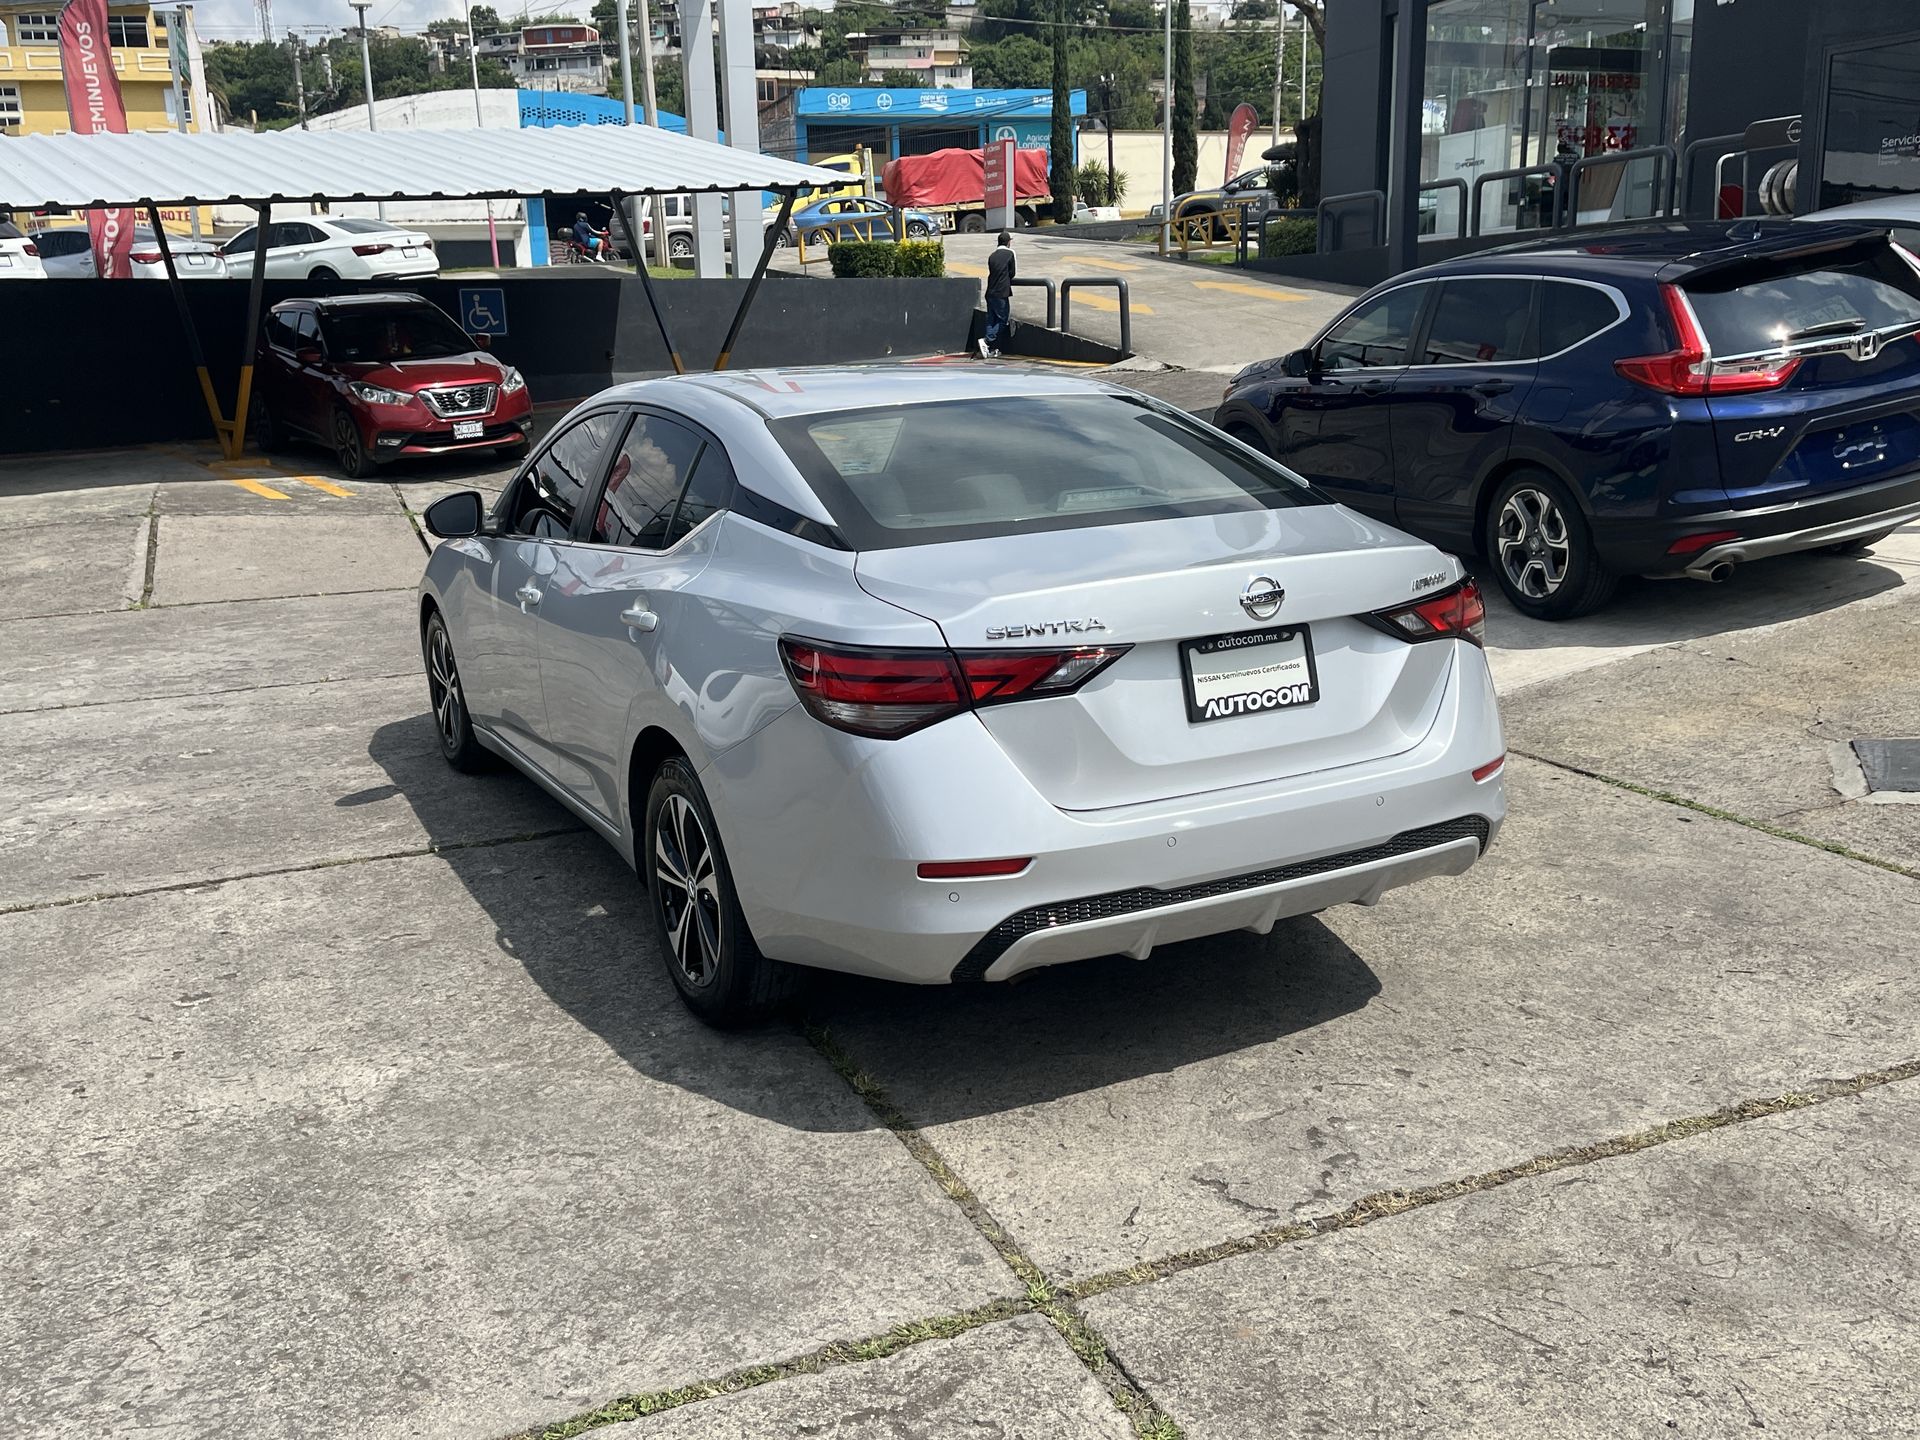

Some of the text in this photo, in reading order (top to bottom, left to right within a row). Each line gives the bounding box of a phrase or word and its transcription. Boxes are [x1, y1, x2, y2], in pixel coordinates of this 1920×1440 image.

[77, 22, 107, 134] EMINUEVOS
[1026, 134, 1052, 142] Agricol
[1735, 426, 1785, 442] CR-V
[986, 616, 1106, 640] SENTRA
[1217, 631, 1278, 649] autocom.mx
[1197, 662, 1301, 684] NISSAN Seminuevos Certificados
[1204, 683, 1310, 719] AUTOCOM
